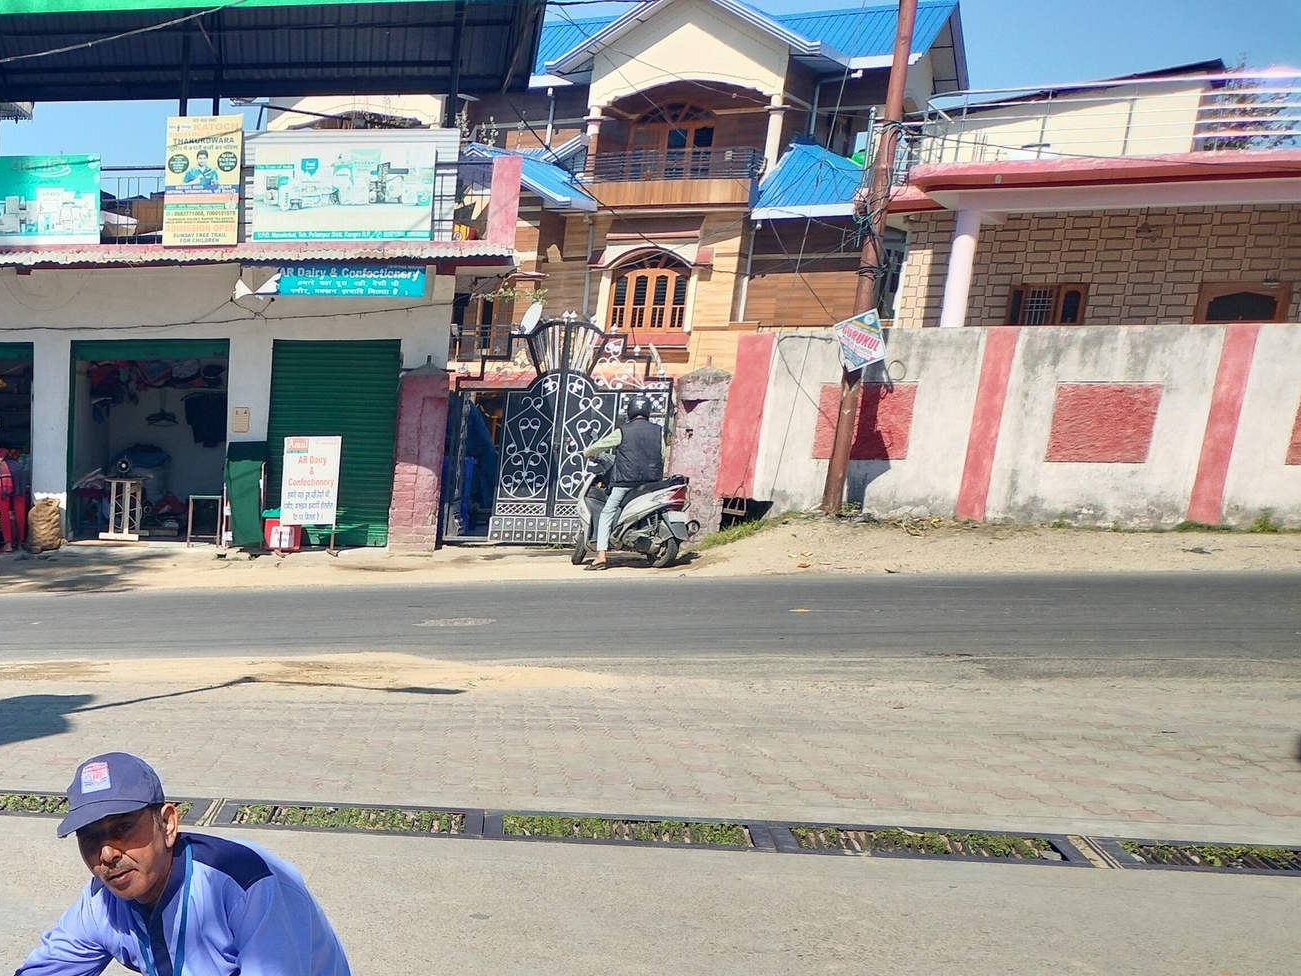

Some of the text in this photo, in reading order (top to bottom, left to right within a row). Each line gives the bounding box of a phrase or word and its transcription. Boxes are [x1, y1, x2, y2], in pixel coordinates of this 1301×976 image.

[193, 123, 239, 131] KATOCH
[344, 231, 361, 239] Kangra
[280, 268, 420, 282] AR Dairy & Confectionery
[368, 287, 390, 295] मिलता
[392, 287, 398, 295] है
[842, 324, 881, 352] GURUKUL
[288, 439, 308, 449] Amul
[298, 455, 328, 466] AR Dairy
[309, 467, 314, 475] &
[288, 478, 334, 488] Confectionery
